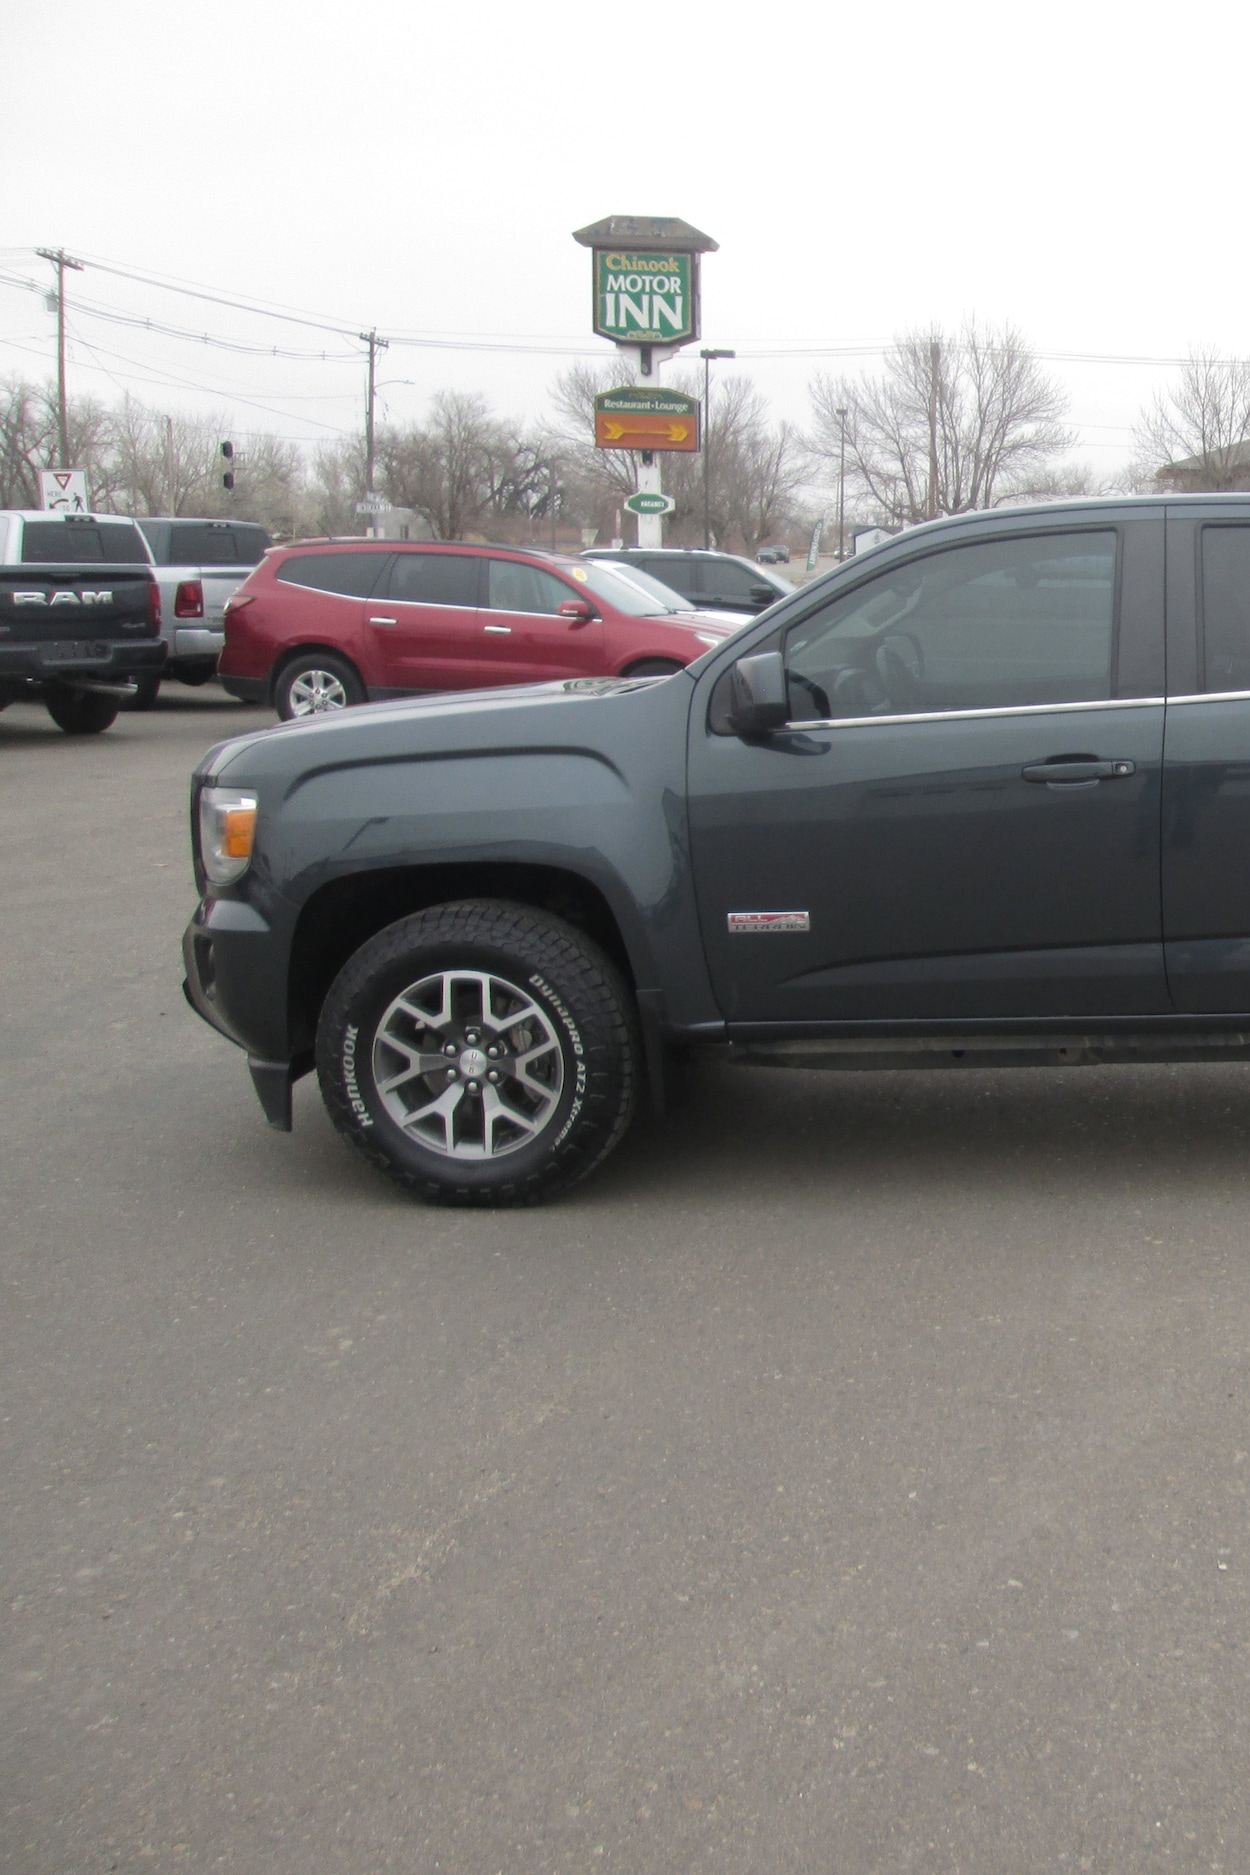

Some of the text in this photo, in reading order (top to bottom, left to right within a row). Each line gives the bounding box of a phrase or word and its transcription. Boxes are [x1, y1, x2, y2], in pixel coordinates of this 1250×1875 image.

[605, 254, 680, 273] Chinook
[606, 274, 682, 294] MOTOR
[605, 292, 684, 330] INN
[604, 399, 689, 413] Restaurant Lounge
[13, 591, 114, 606] RAM
[575, 1060, 587, 1094] AT2
